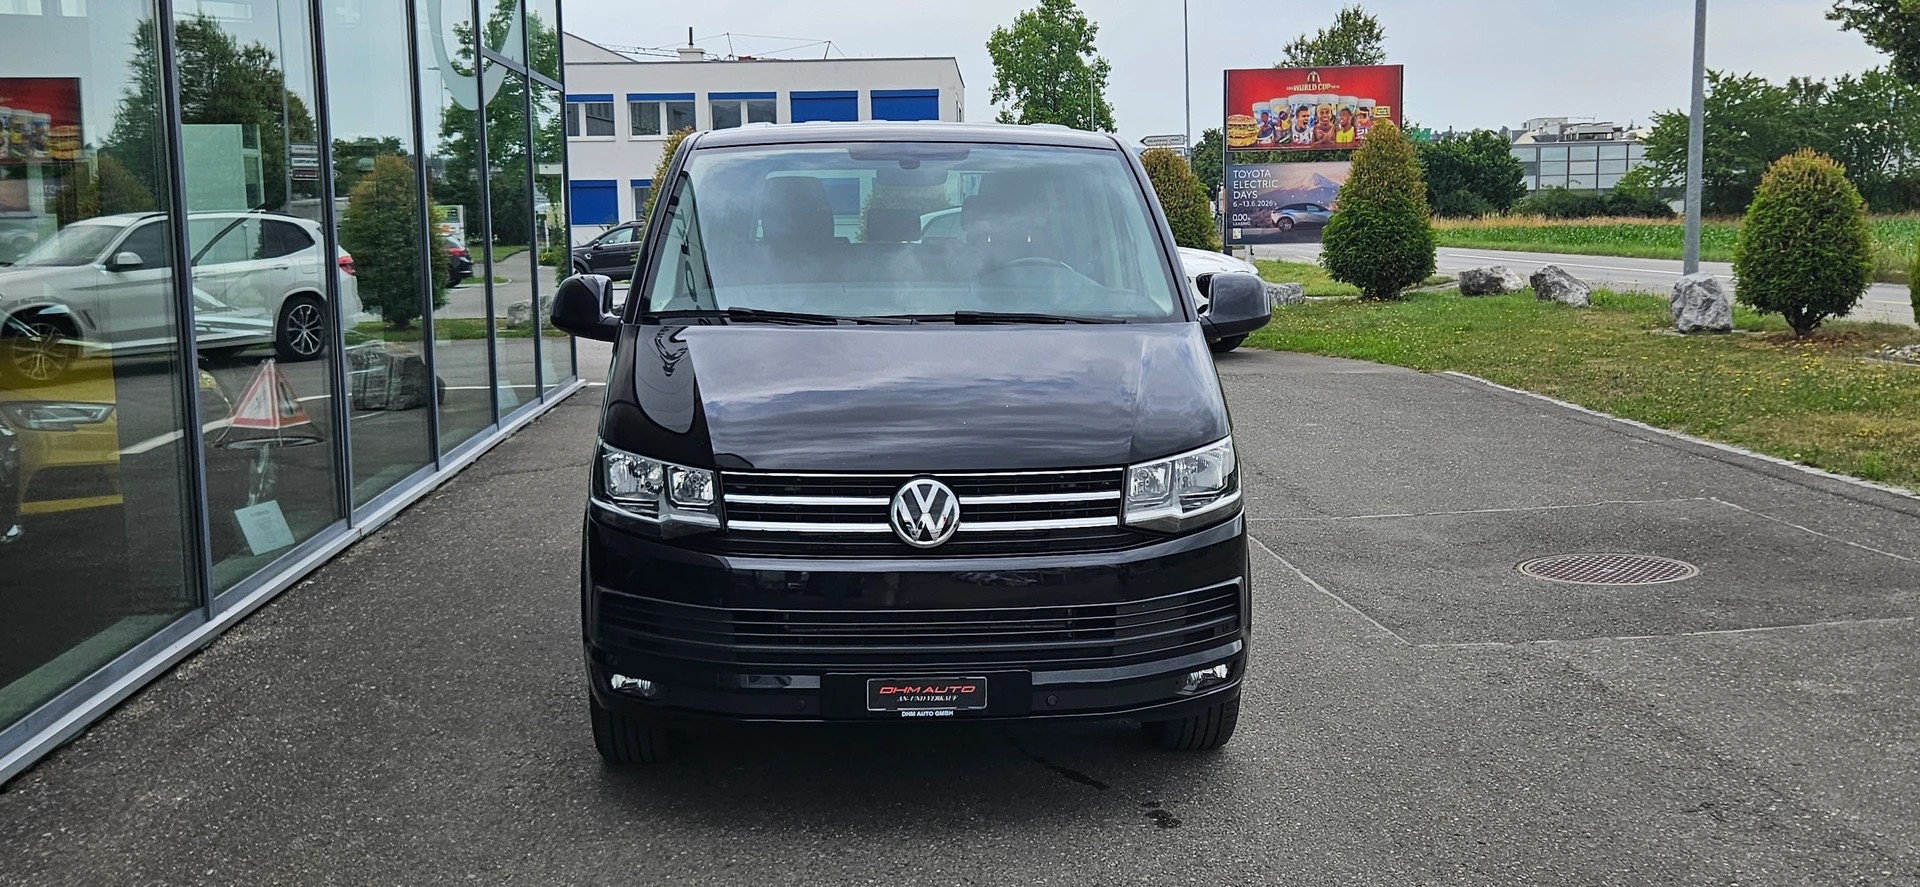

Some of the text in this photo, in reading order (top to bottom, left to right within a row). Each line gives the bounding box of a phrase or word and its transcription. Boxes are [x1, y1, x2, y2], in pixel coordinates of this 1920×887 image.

[1318, 83, 1331, 91] CUP
[1233, 169, 1272, 179] TOYOTA
[1233, 179, 1279, 189] ELECTRIC
[1233, 190, 1258, 200] DAYS
[893, 481, 958, 545] VW
[879, 685, 976, 694] DHM AUTO
